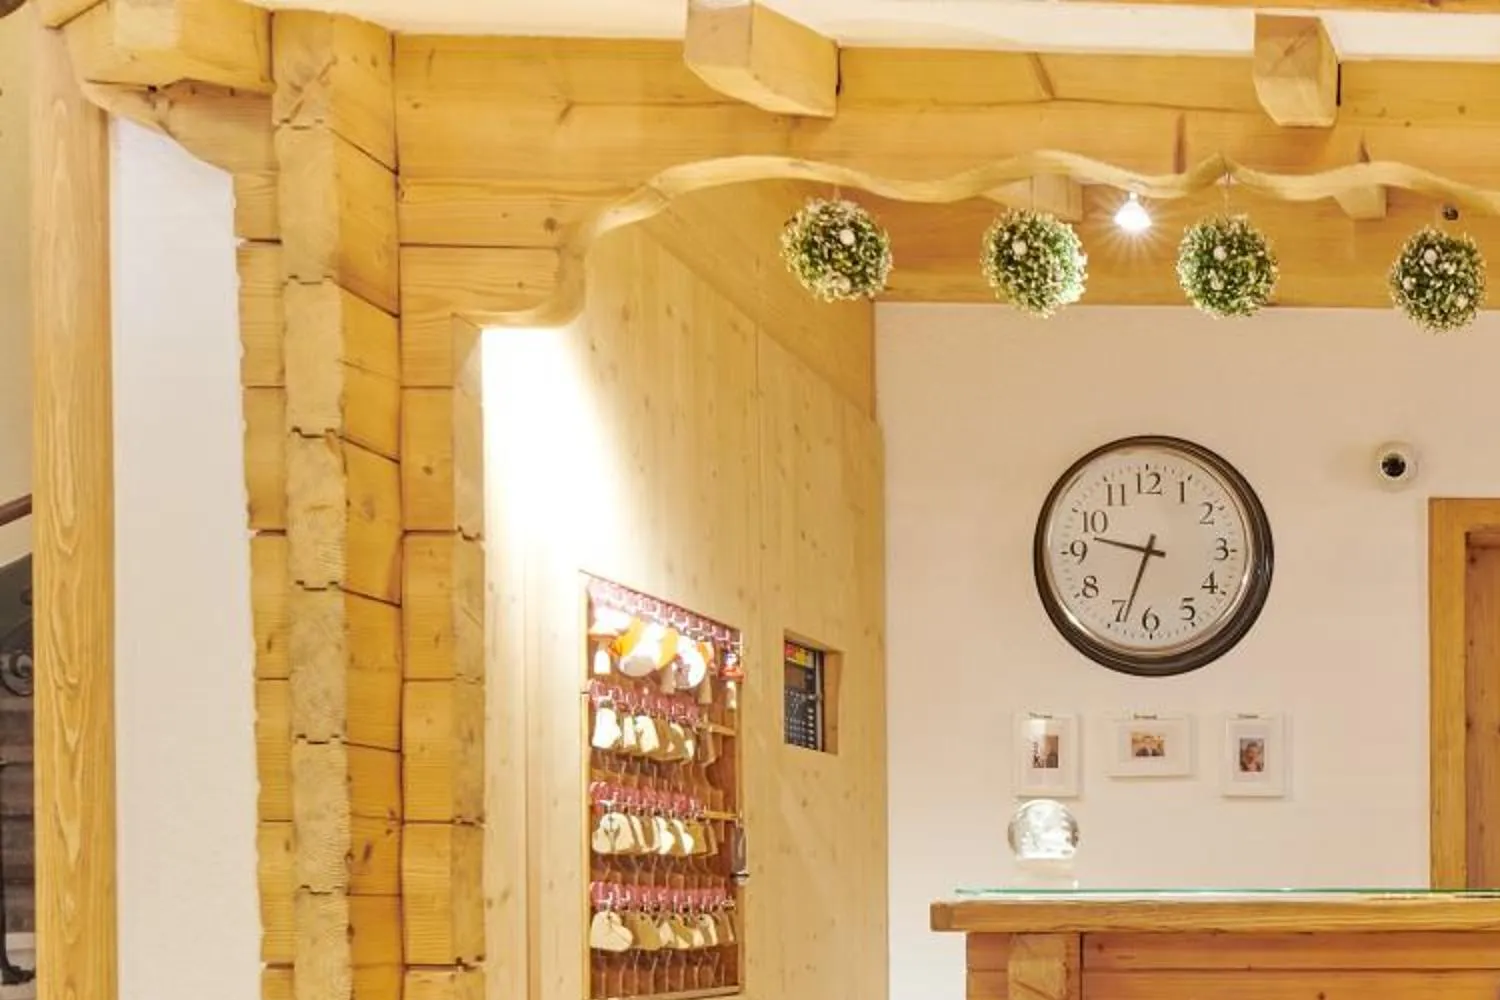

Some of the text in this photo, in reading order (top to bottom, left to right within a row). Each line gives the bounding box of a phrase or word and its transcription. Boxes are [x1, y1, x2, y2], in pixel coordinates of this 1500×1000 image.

[1107, 483, 1127, 506] 11
[1136, 472, 1163, 495] 12
[1178, 480, 1186, 503] 1
[1082, 510, 1109, 533] 10
[1199, 502, 1215, 525] 2
[1070, 539, 1088, 564] 9
[1214, 537, 1229, 561] 3
[1081, 575, 1099, 598] 8
[1201, 571, 1218, 594] 4
[1111, 599, 1127, 623] 7
[1142, 607, 1160, 632] 6
[1180, 597, 1196, 621] 5
